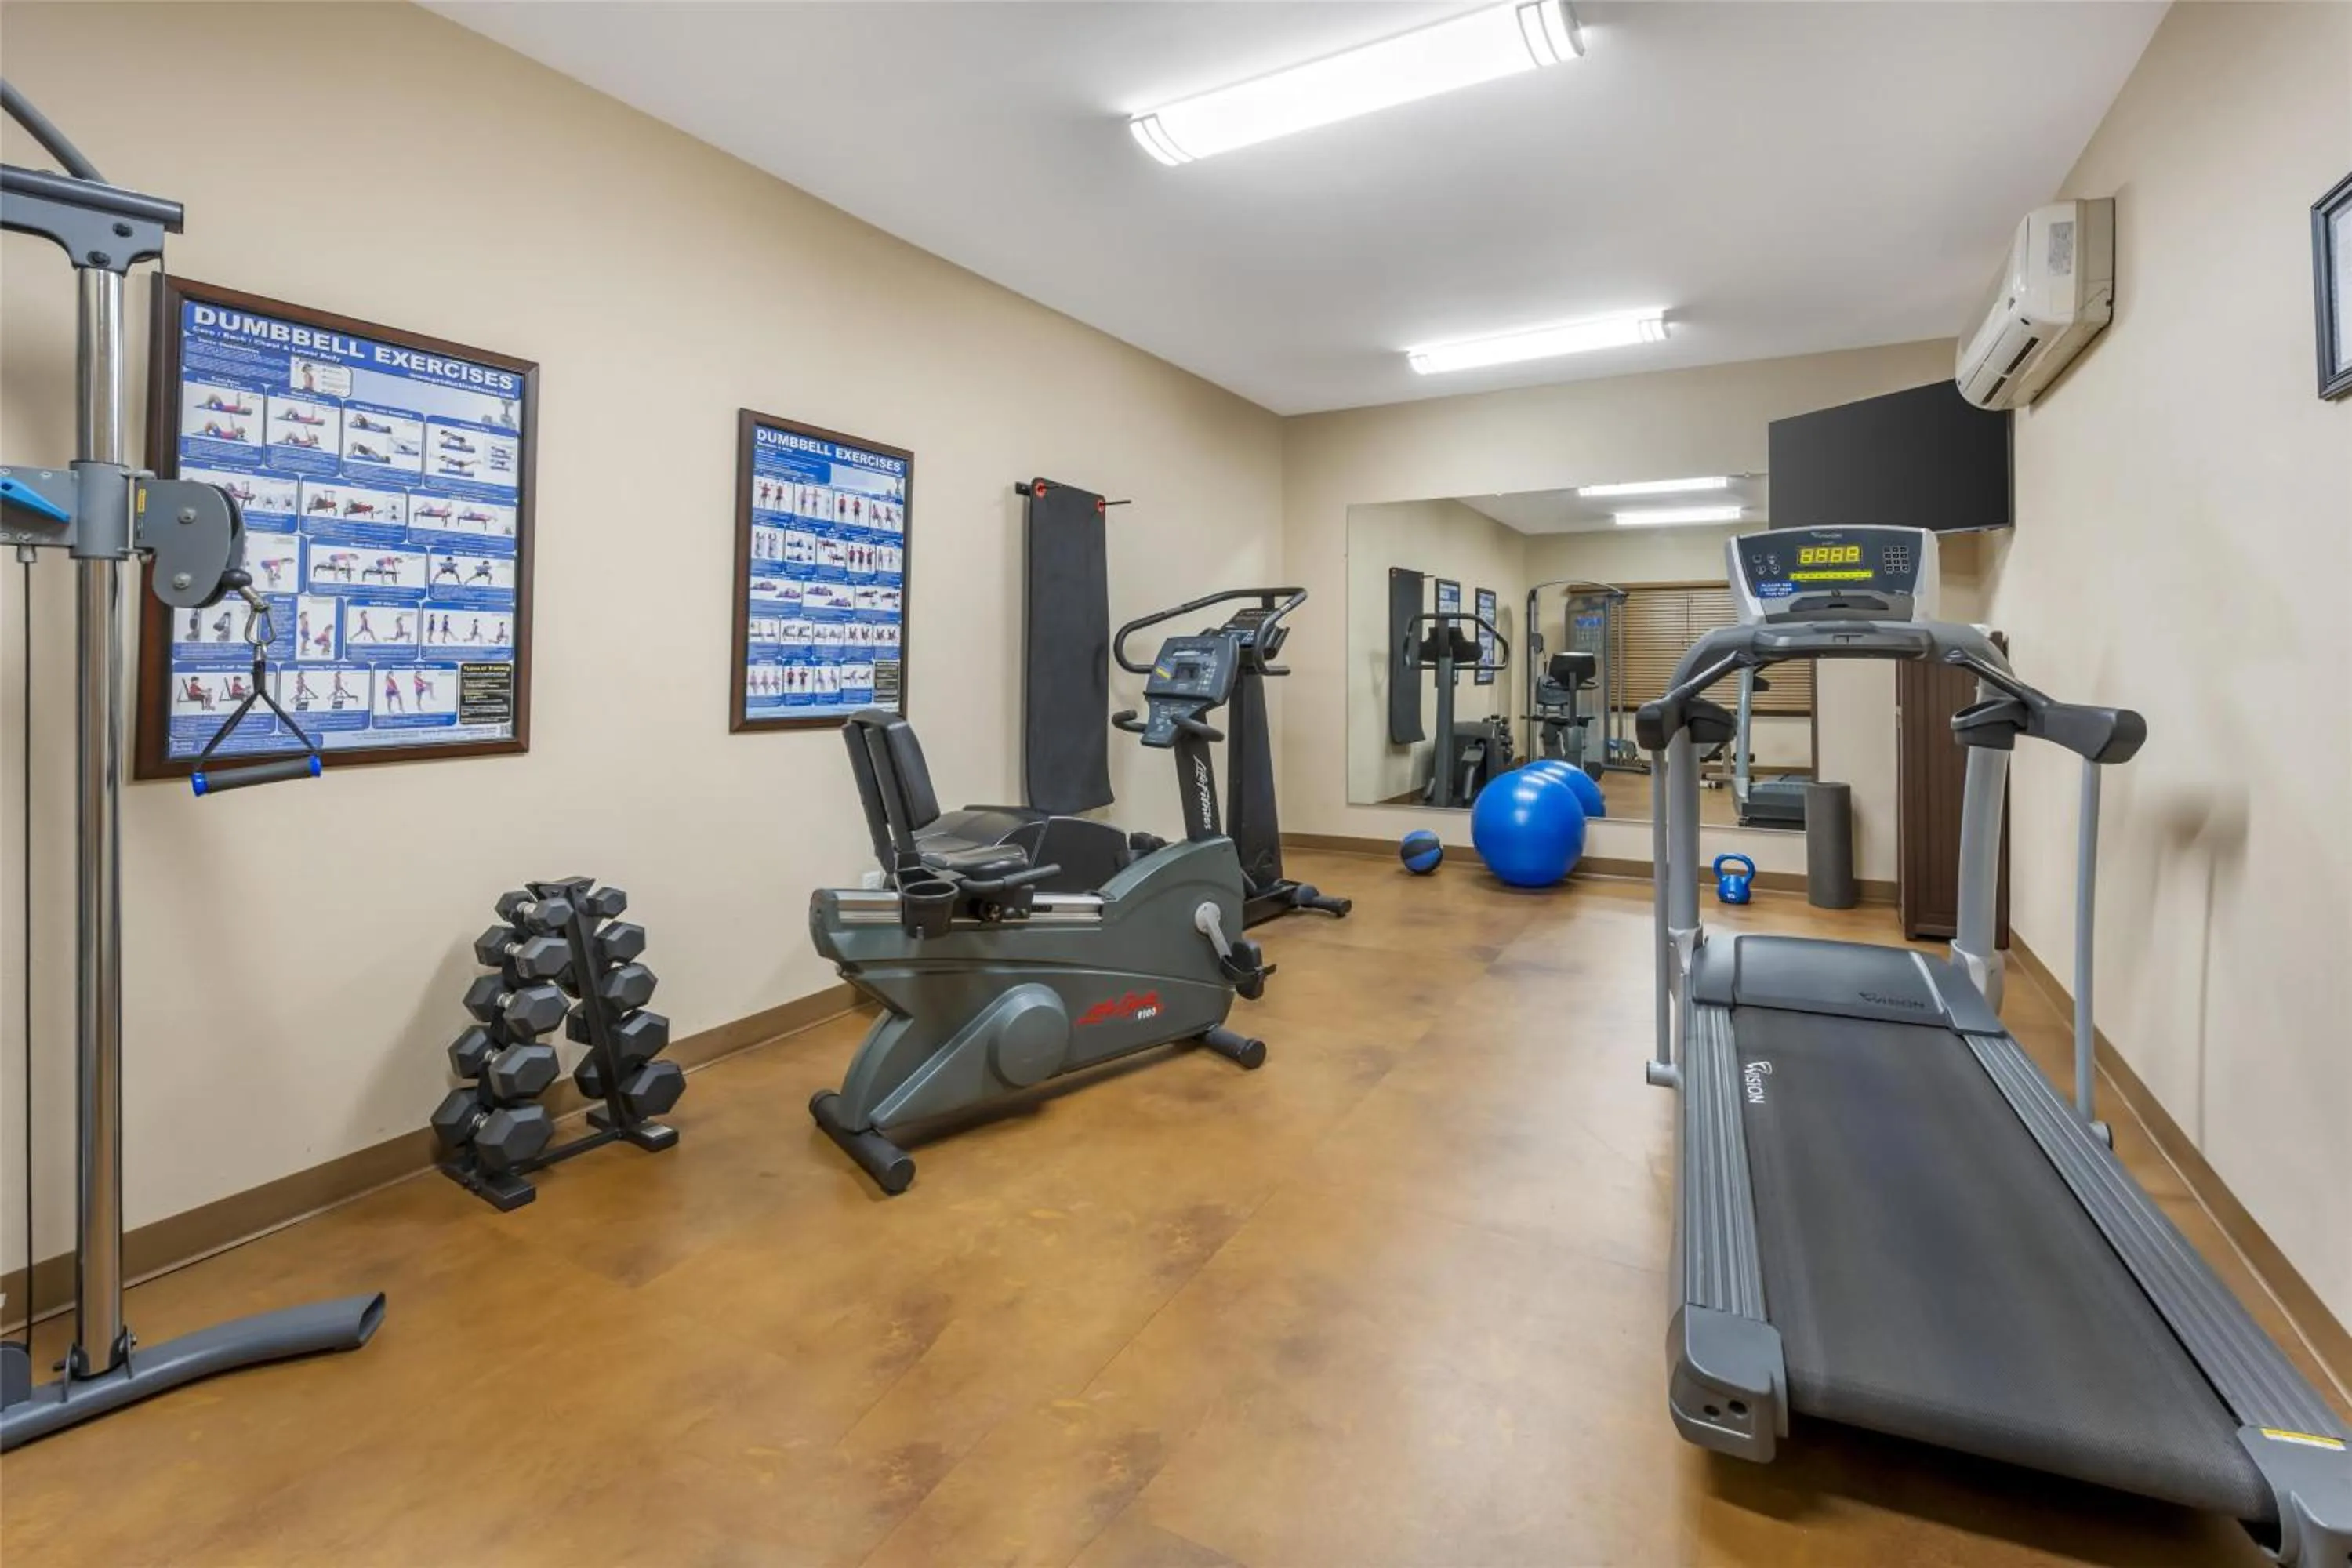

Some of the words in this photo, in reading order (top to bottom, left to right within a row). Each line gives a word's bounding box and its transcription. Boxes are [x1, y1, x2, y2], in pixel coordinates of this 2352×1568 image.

[194, 305, 365, 358] DUMBBELL
[374, 345, 514, 390] EXERCISES
[757, 429, 831, 456] DUMBBELL
[835, 447, 901, 472] EXERCISES
[1744, 1061, 1773, 1104] VISION
